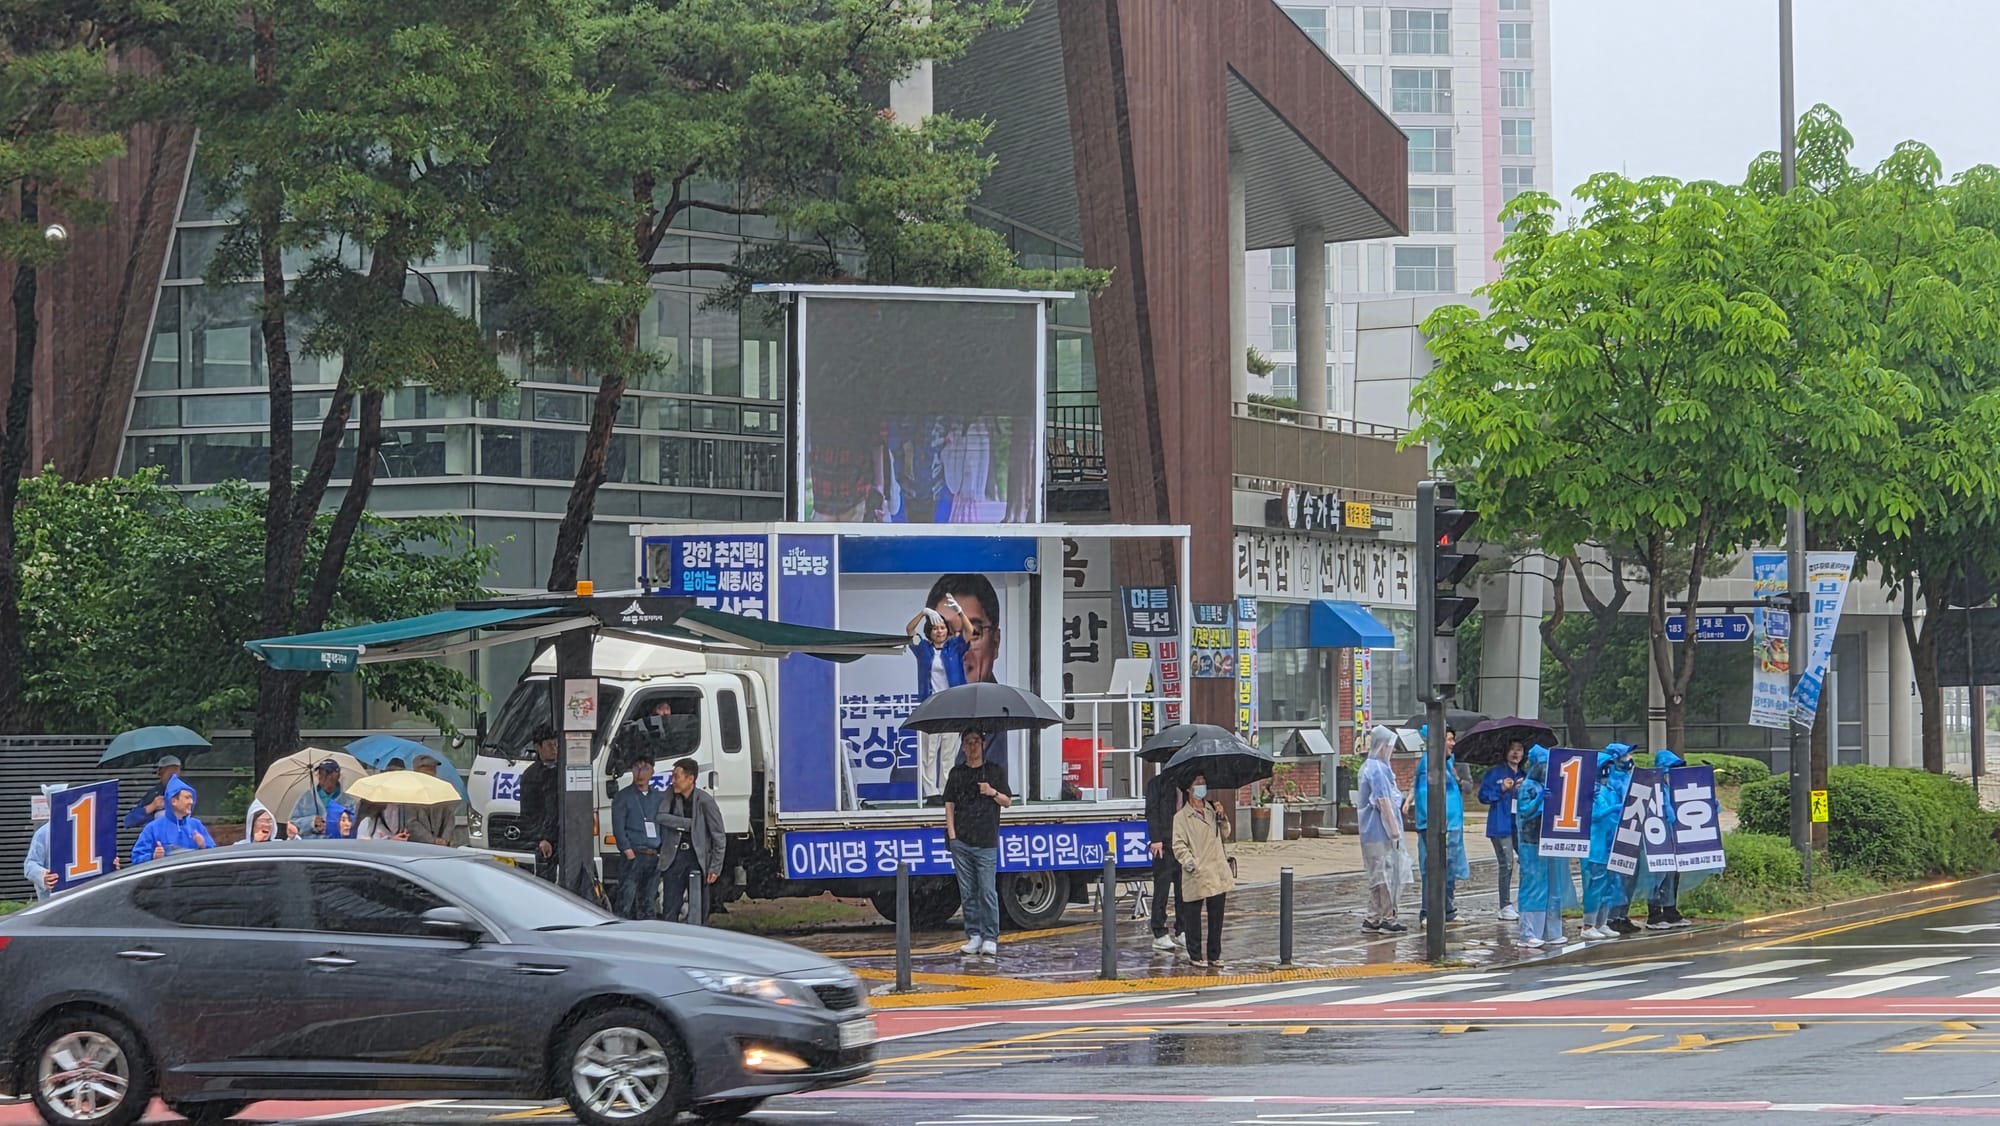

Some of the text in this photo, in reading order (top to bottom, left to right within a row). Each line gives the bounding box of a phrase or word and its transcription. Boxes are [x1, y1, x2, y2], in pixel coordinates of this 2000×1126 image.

[682, 541, 764, 568] 강한 추진력!
[782, 555, 829, 576] 민주당
[683, 571, 764, 592] 일하는 세종시장
[1319, 548, 1408, 600] 선지해장국
[1130, 588, 1169, 609] 여름
[1132, 611, 1170, 632] 특선
[1553, 756, 1583, 833] 1
[1673, 782, 1718, 844] 호
[67, 792, 102, 881] 1
[792, 840, 868, 875] 이재명
[874, 839, 926, 872] 정부
